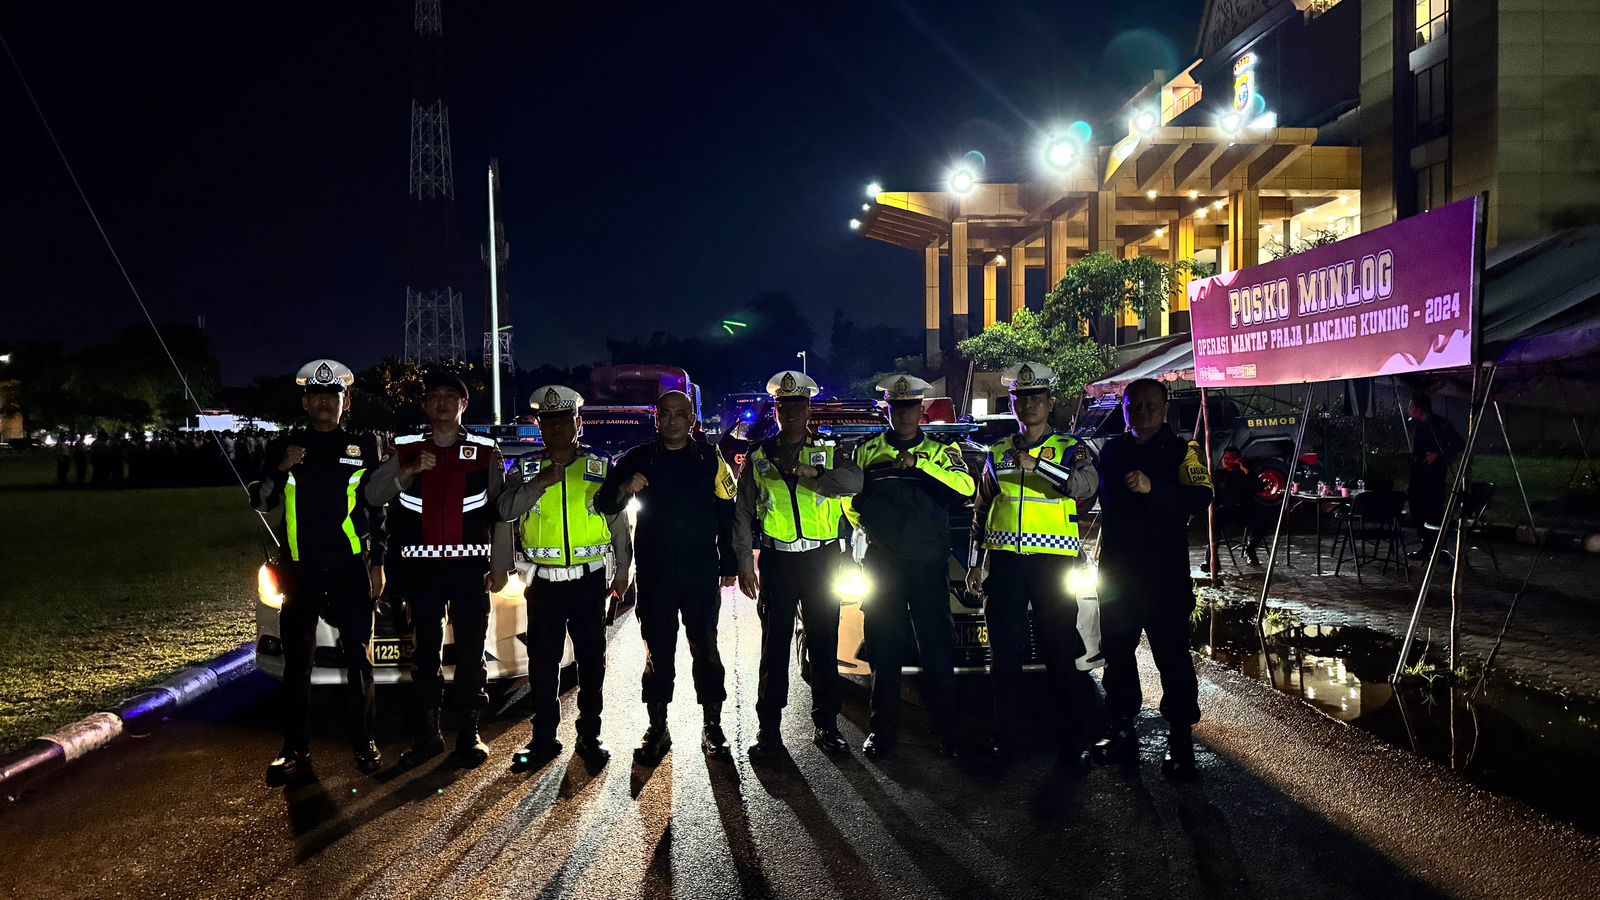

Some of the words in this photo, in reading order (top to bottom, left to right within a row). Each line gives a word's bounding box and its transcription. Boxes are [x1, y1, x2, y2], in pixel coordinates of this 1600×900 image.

[1229, 278, 1290, 328] POSKO
[1298, 249, 1393, 316] MINLOG
[1197, 336, 1229, 356] OPERASI
[1230, 331, 1268, 353] MANTAP
[1270, 325, 1302, 349] PRAJA
[1305, 315, 1357, 345] LANCANG
[1360, 304, 1409, 336] KUNING
[1425, 292, 1460, 324] 2024
[1247, 417, 1296, 428] BRIMOB
[375, 645, 400, 660] 1225
